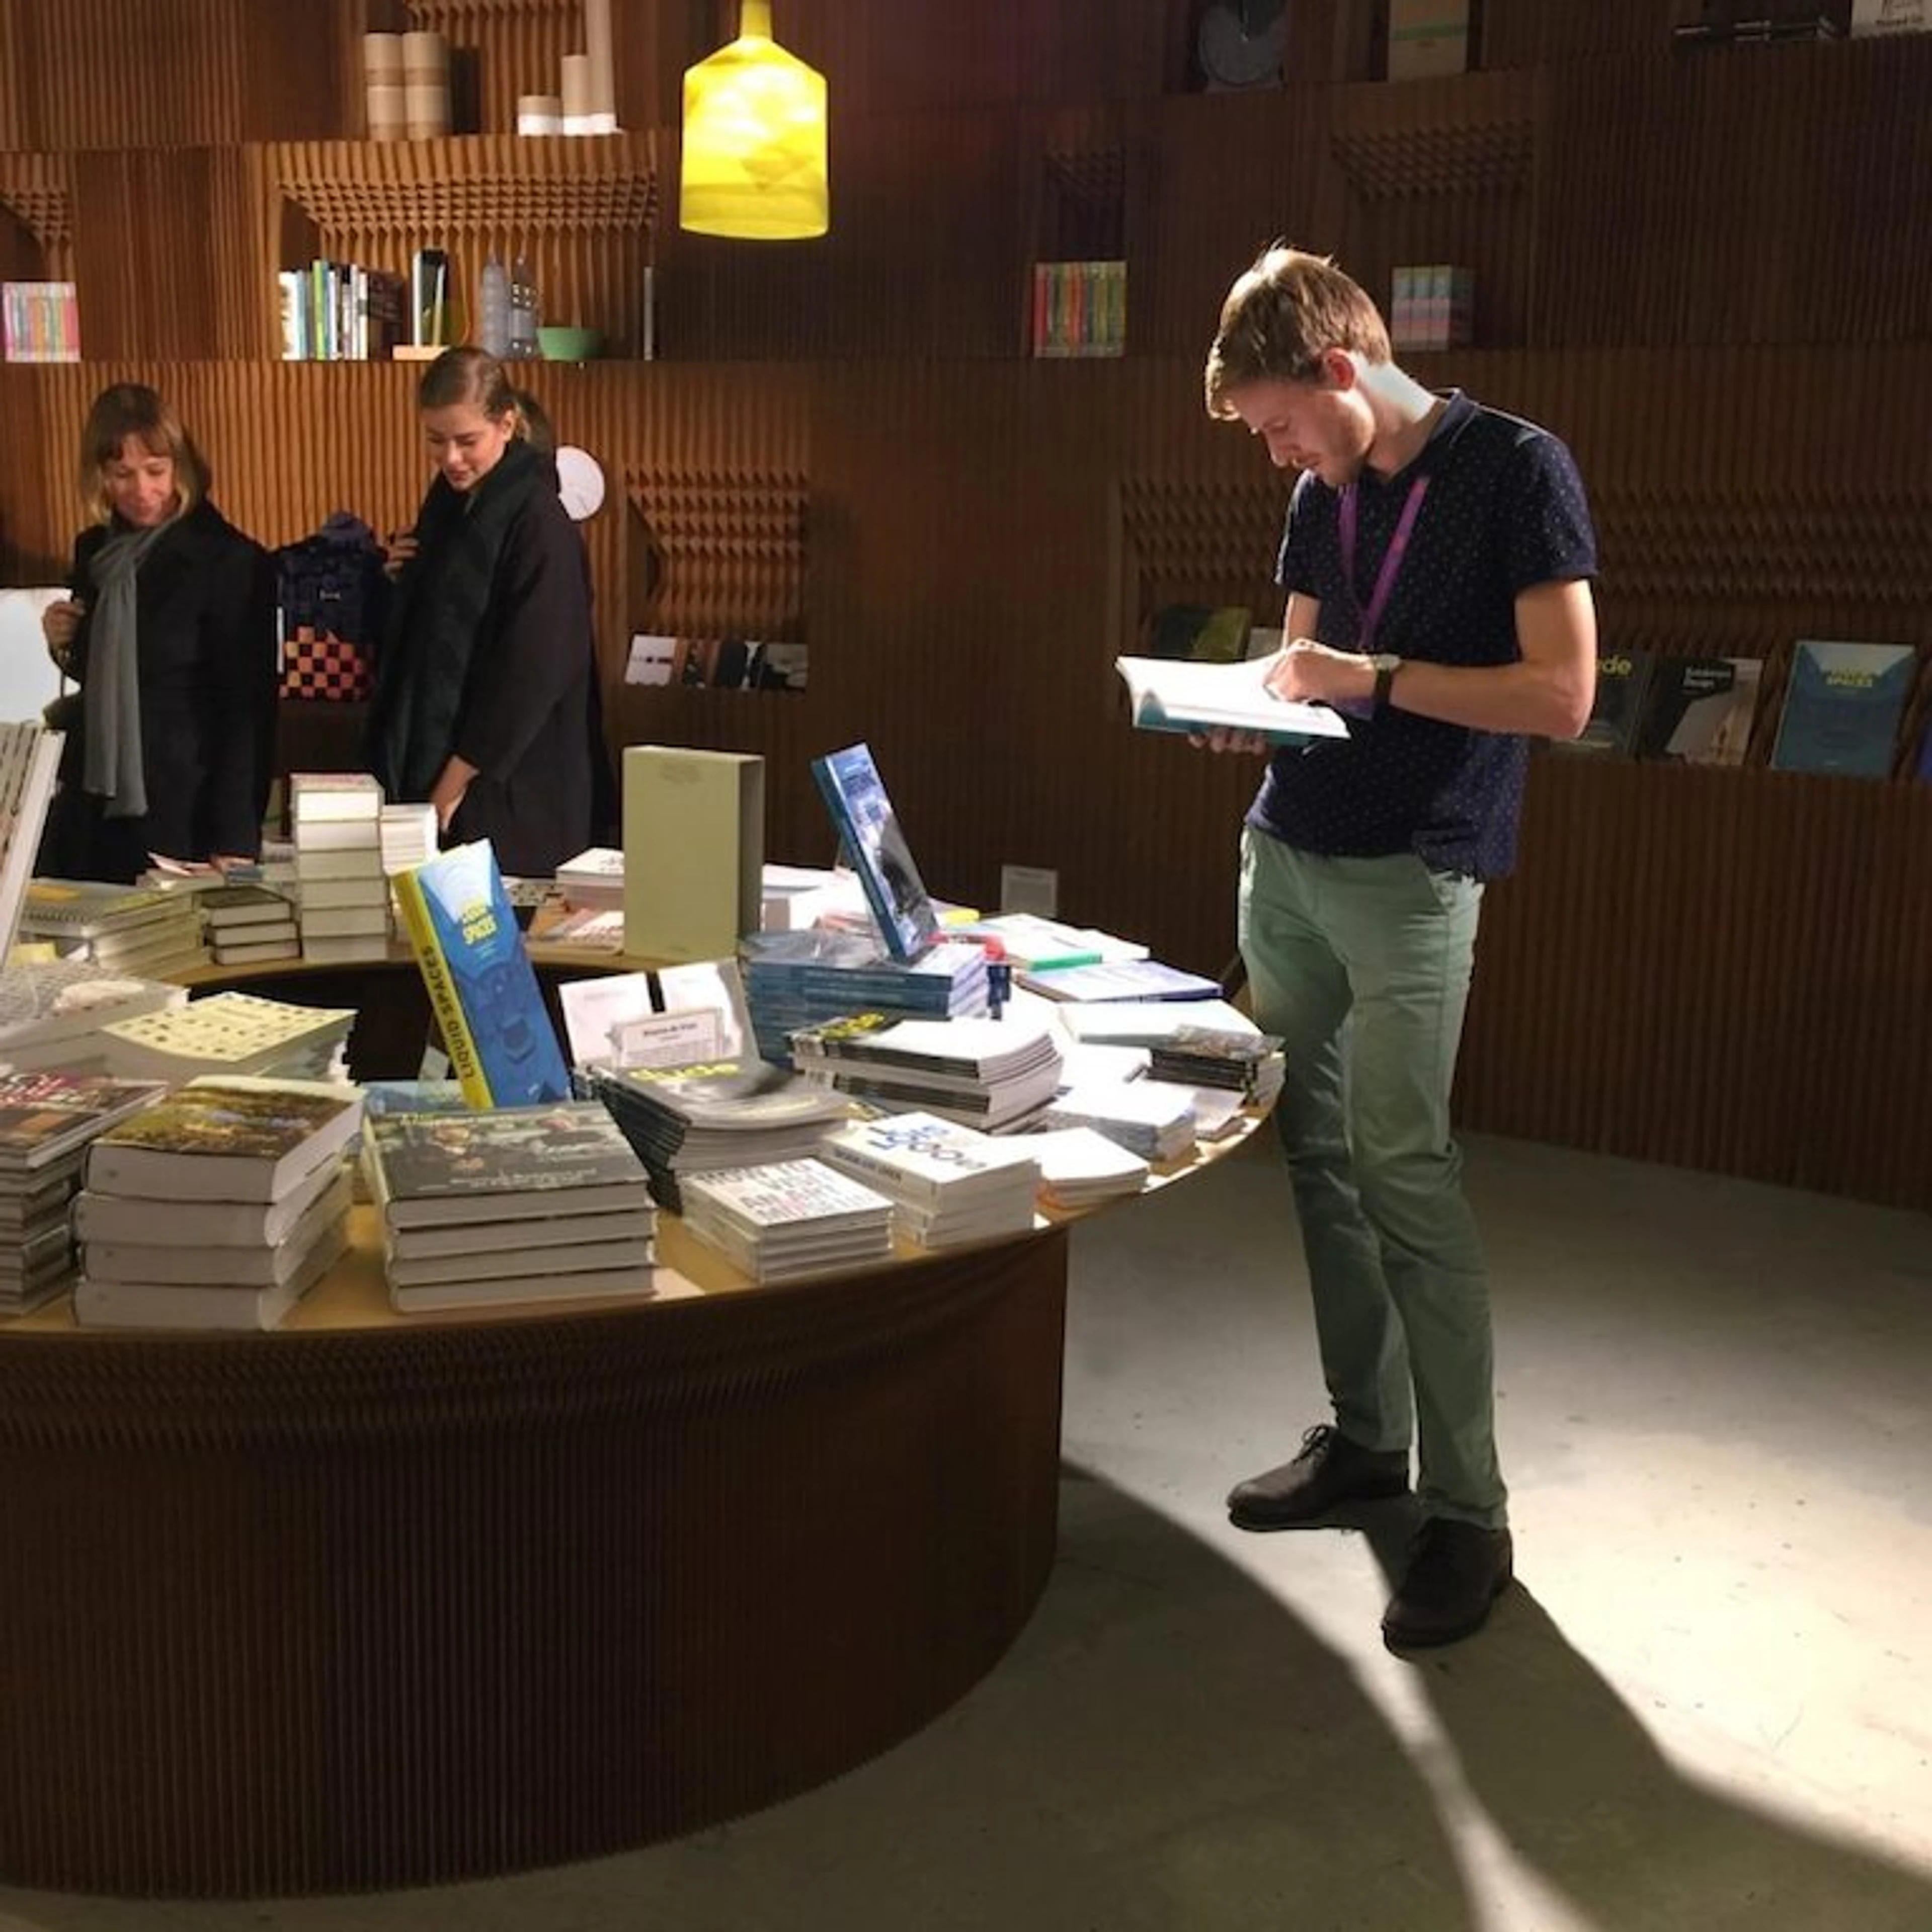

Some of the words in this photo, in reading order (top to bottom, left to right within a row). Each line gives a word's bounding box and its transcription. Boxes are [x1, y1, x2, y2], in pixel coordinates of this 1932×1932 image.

[1596, 655, 1632, 675] de
[422, 945, 455, 1013] SPACES
[447, 1021, 474, 1078] LIQUID
